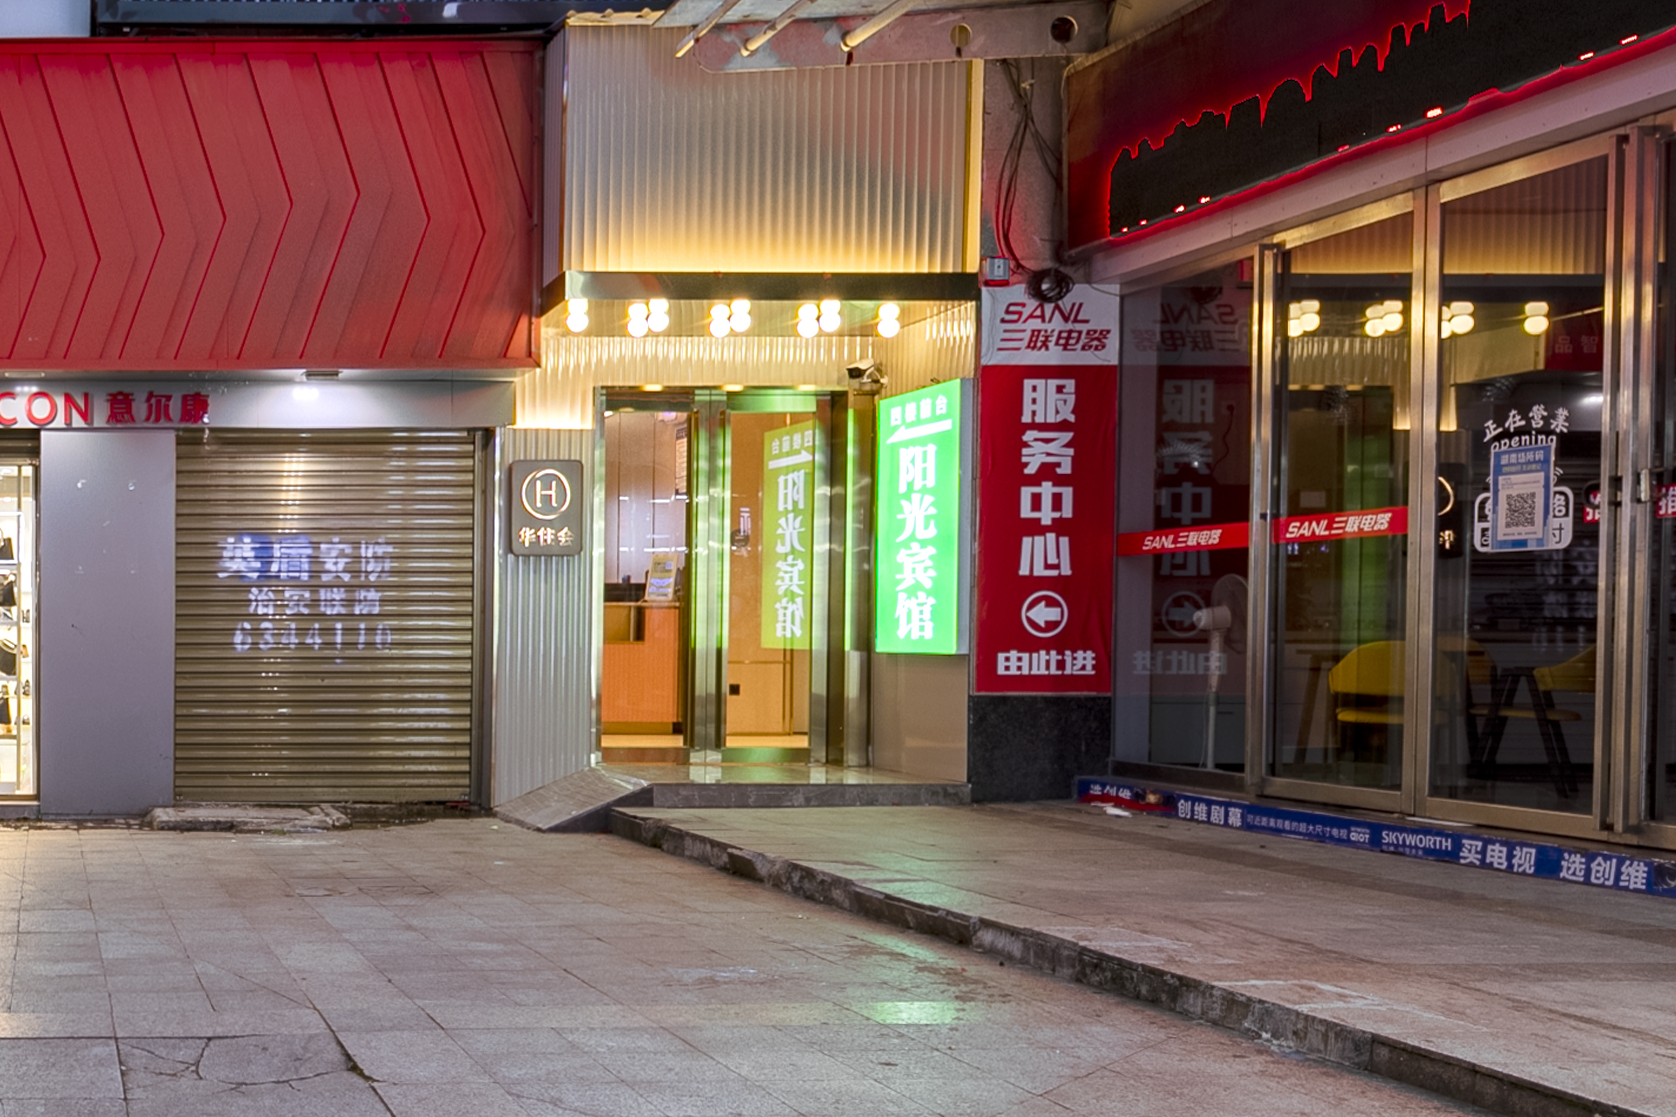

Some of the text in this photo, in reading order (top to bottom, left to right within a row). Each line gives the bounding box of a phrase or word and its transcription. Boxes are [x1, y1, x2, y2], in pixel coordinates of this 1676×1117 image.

[999, 301, 1091, 325] SANL
[997, 328, 1111, 353] 三联电器
[105, 391, 211, 425] 意尔康
[890, 394, 949, 427] 四楼前台
[1018, 378, 1076, 577] 服务中心
[517, 525, 576, 549] 华住会
[895, 443, 938, 641] 阳光宾馆
[232, 621, 393, 652] 6344110
[996, 649, 1097, 676] 由此进
[1176, 798, 1243, 829] 创维剧幕
[1246, 812, 1349, 841] 可近距离观看的超大尺寸电视
[1382, 830, 1452, 852] SKYWORTH
[1459, 838, 1648, 891] 买电视 选创维
